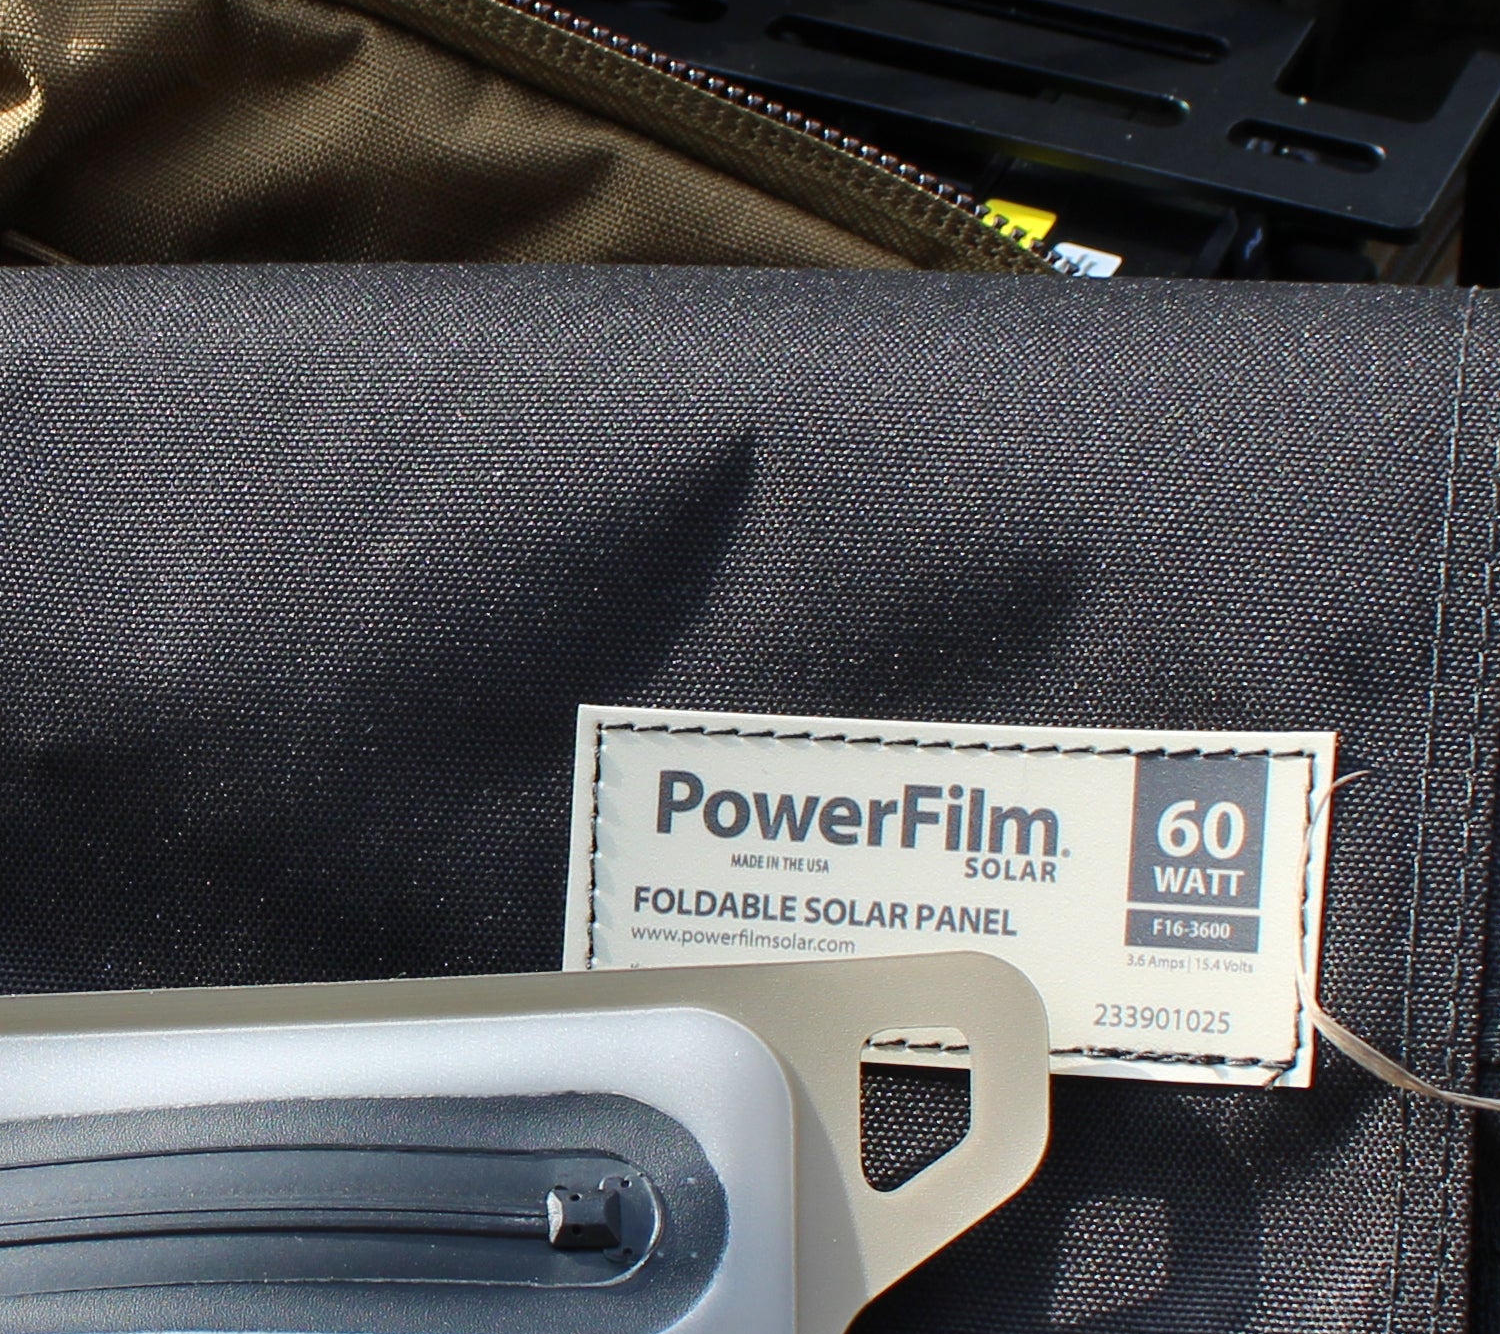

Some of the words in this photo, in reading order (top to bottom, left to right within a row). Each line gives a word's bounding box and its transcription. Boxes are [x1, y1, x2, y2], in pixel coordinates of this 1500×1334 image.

[655, 769, 1062, 857] PowerFilm
[1156, 799, 1246, 860] 60
[730, 852, 765, 869] MADE
[766, 854, 780, 870] IN
[782, 855, 805, 872] THE
[806, 857, 830, 874] USA
[963, 856, 1058, 884] SOLAR
[1152, 865, 1246, 897] WATT
[633, 885, 797, 923] FOLDABLE
[803, 896, 908, 930] SOLAR
[914, 903, 1018, 937] PANEL
[630, 924, 857, 955] www.powerfilmsolar.com
[1152, 918, 1232, 940] F16-3600
[1126, 953, 1146, 967] 3.6
[1148, 954, 1185, 971] Amps
[1195, 957, 1221, 971] 15.4
[1223, 958, 1255, 975] Volts
[1092, 1002, 1232, 1035] 233901025
